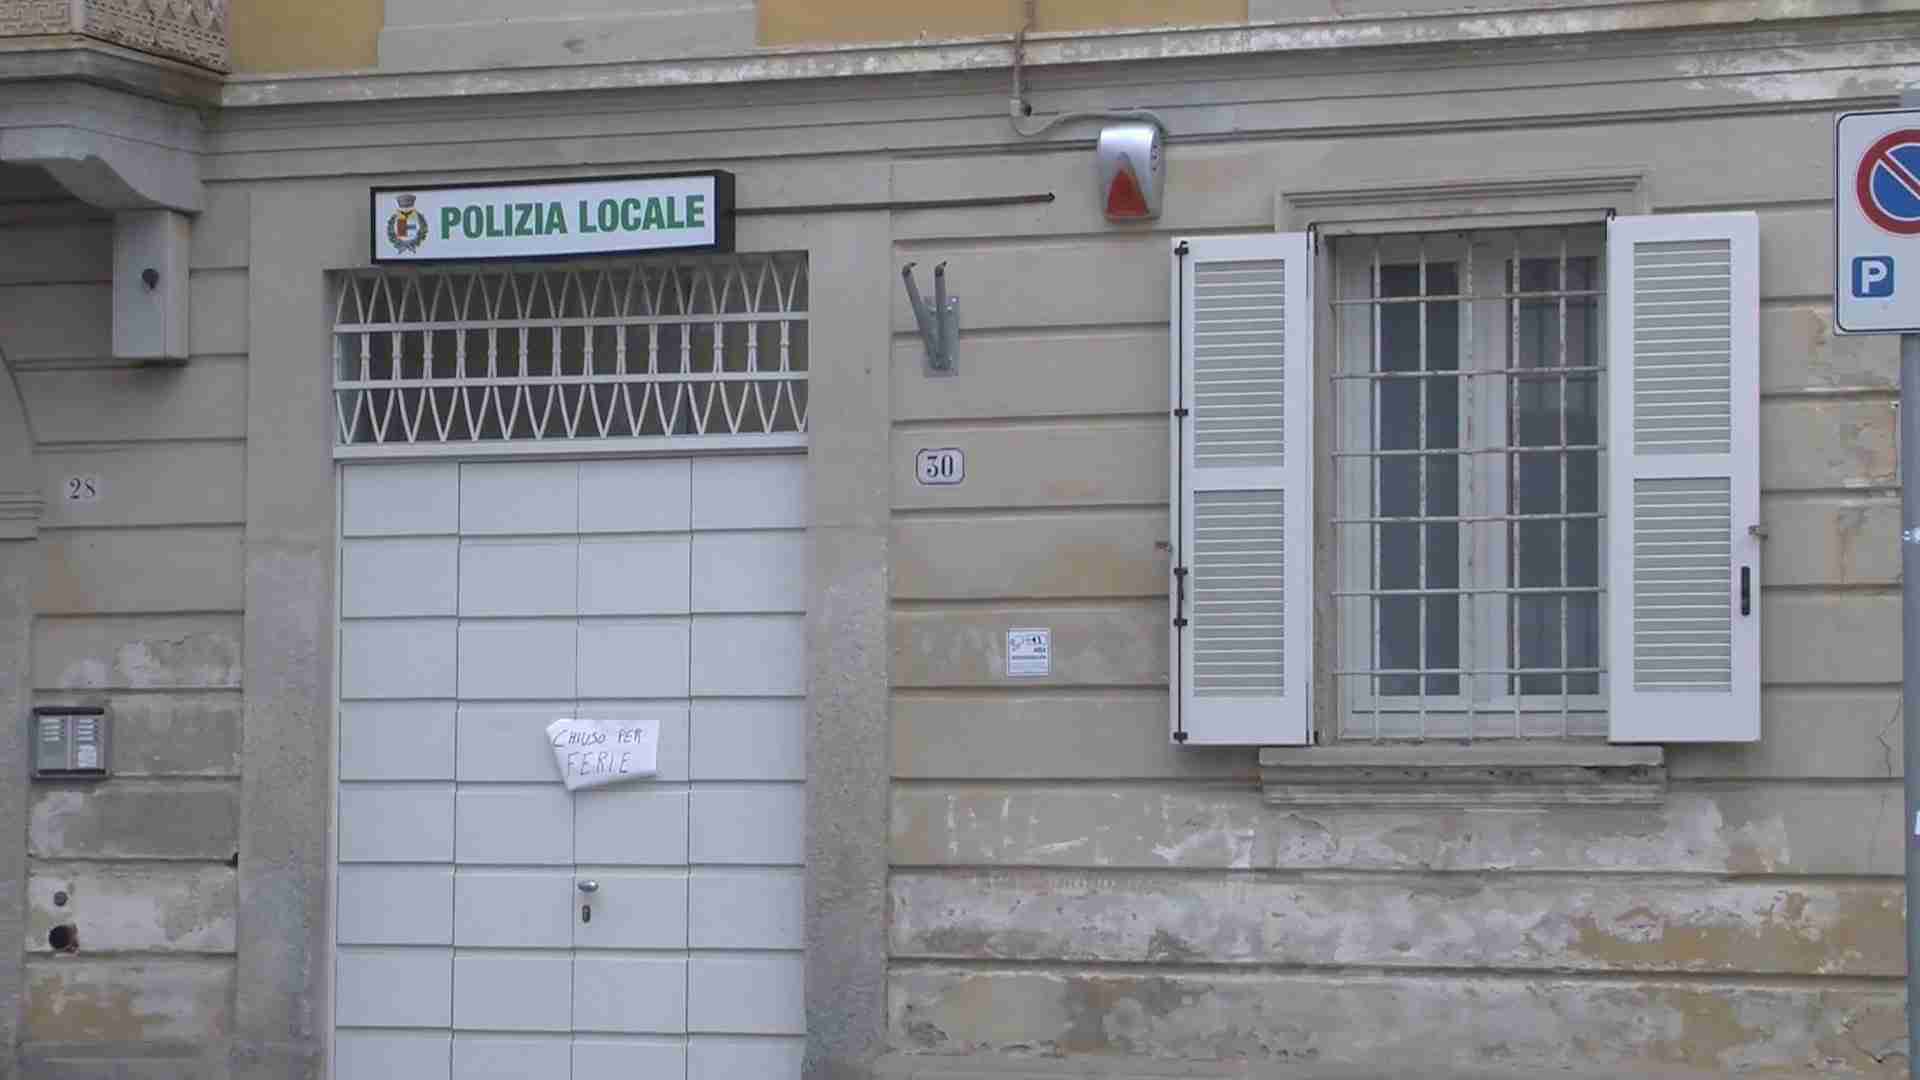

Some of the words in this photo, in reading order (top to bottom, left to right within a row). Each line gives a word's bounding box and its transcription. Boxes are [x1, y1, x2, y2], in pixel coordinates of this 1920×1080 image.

[440, 201, 568, 240] POLIZIA
[578, 194, 705, 233] LOCALE
[1861, 260, 1888, 294] P
[927, 454, 954, 478] 30
[69, 477, 97, 500] 28
[553, 728, 606, 748] CHIUSO
[616, 727, 643, 744] PER
[567, 751, 632, 776] FERIE
